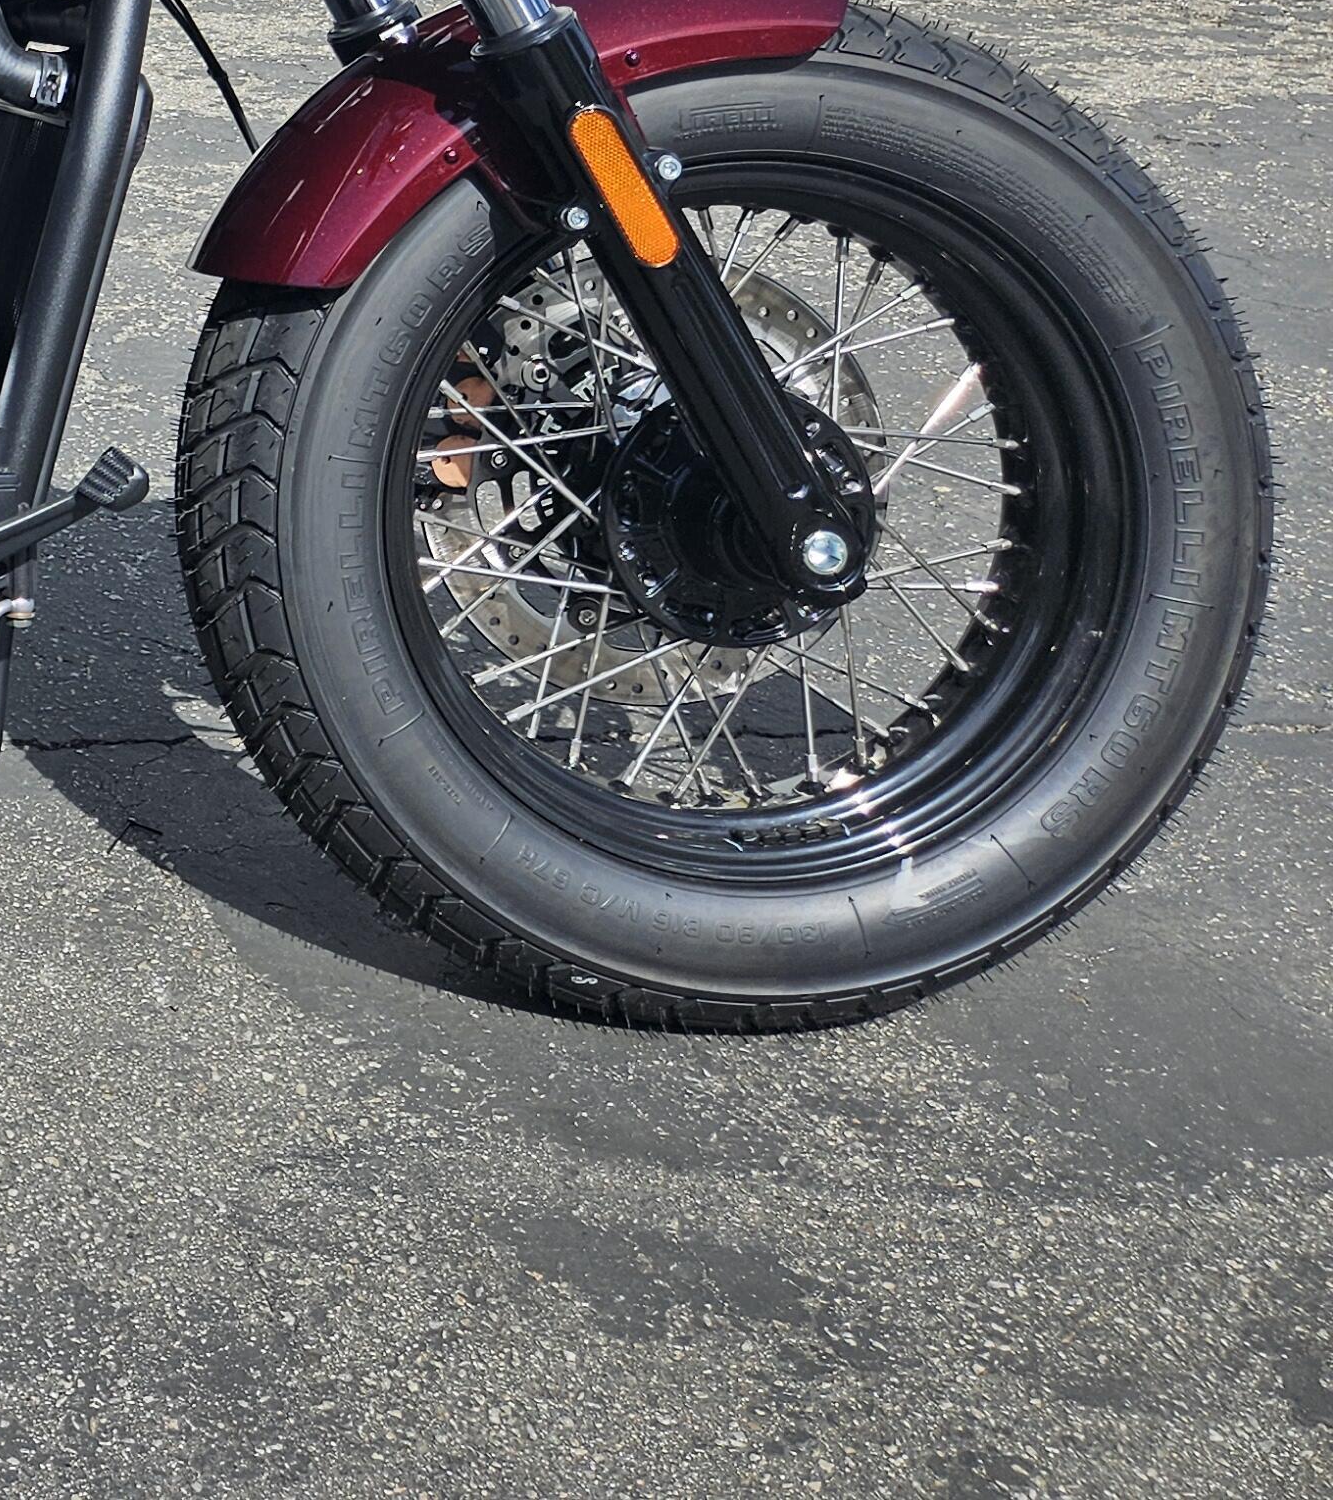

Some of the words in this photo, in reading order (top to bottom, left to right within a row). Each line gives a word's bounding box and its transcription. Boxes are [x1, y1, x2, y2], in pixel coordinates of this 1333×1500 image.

[1135, 340, 1205, 588] PIRELLI
[338, 471, 405, 716] PIRELLI
[715, 920, 829, 946] 130/90
